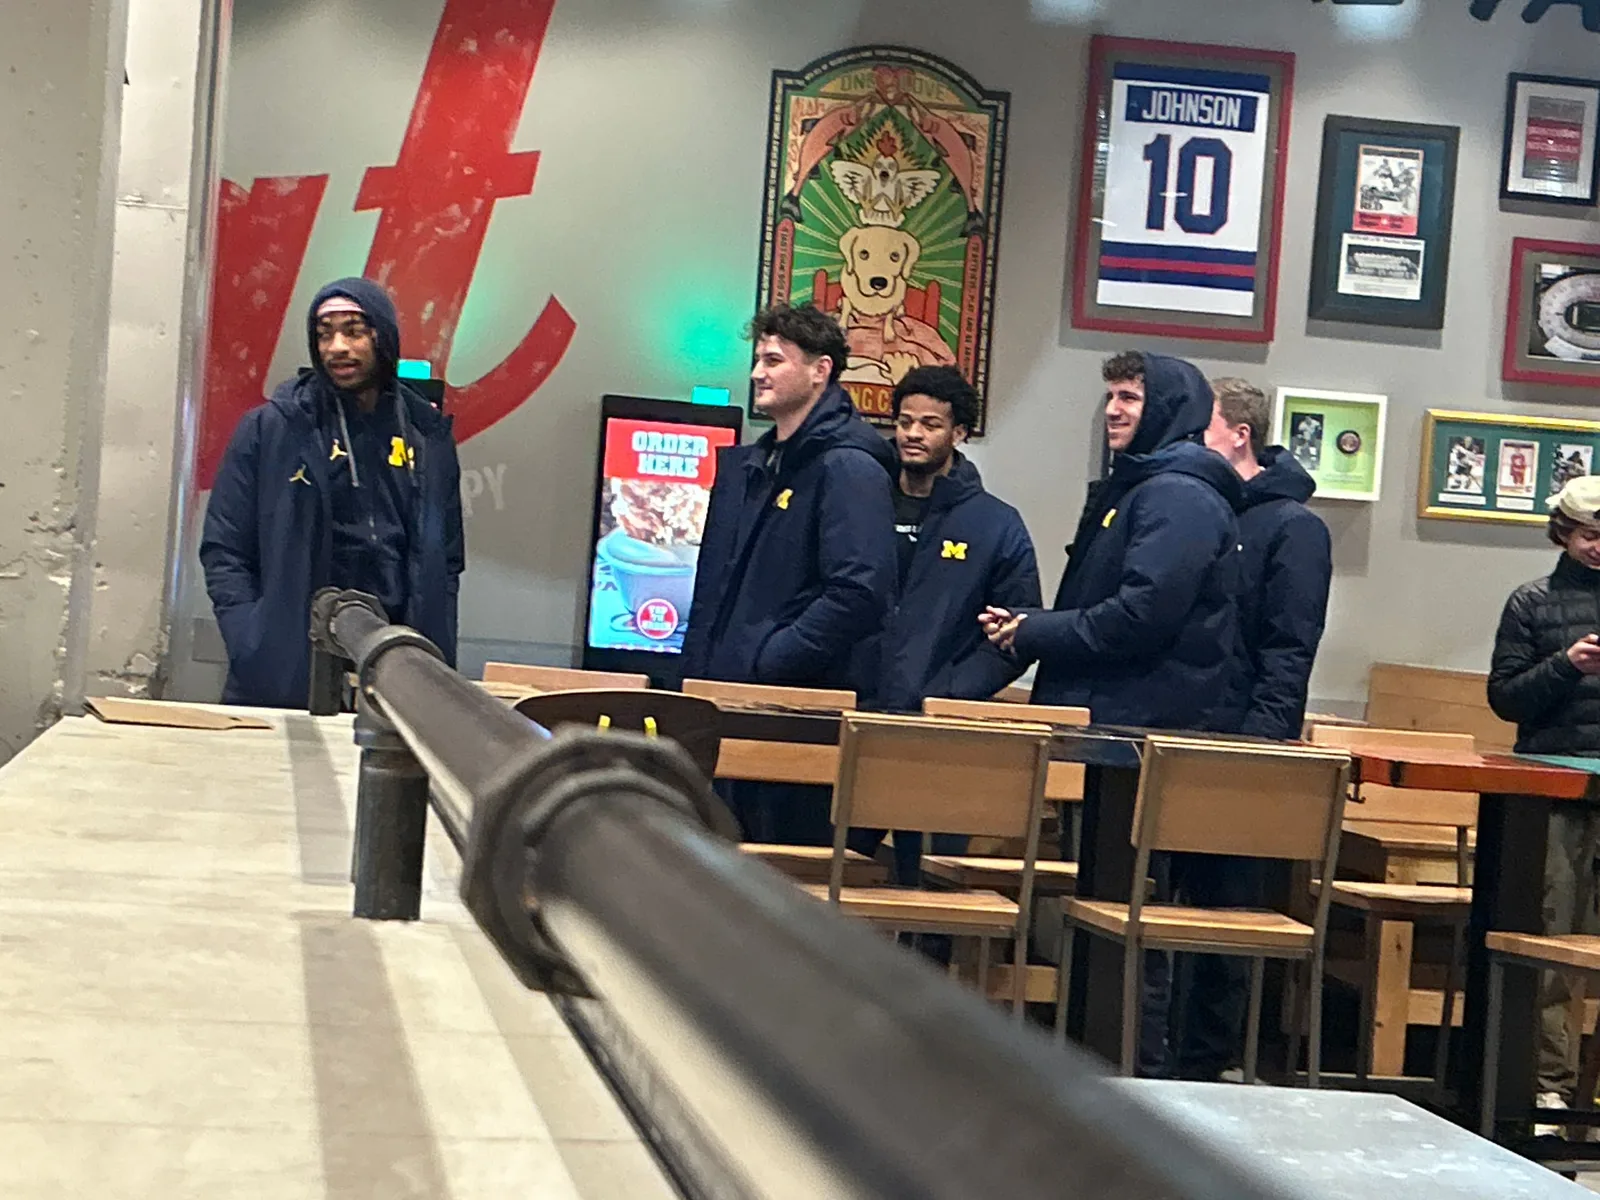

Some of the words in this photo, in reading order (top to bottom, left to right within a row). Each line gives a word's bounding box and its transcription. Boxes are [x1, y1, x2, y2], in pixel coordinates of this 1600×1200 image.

[1141, 90, 1242, 128] JOHNSON
[1142, 133, 1233, 236] 10
[632, 431, 708, 458] ORDER
[637, 453, 699, 478] HERE
[941, 540, 968, 560] M
